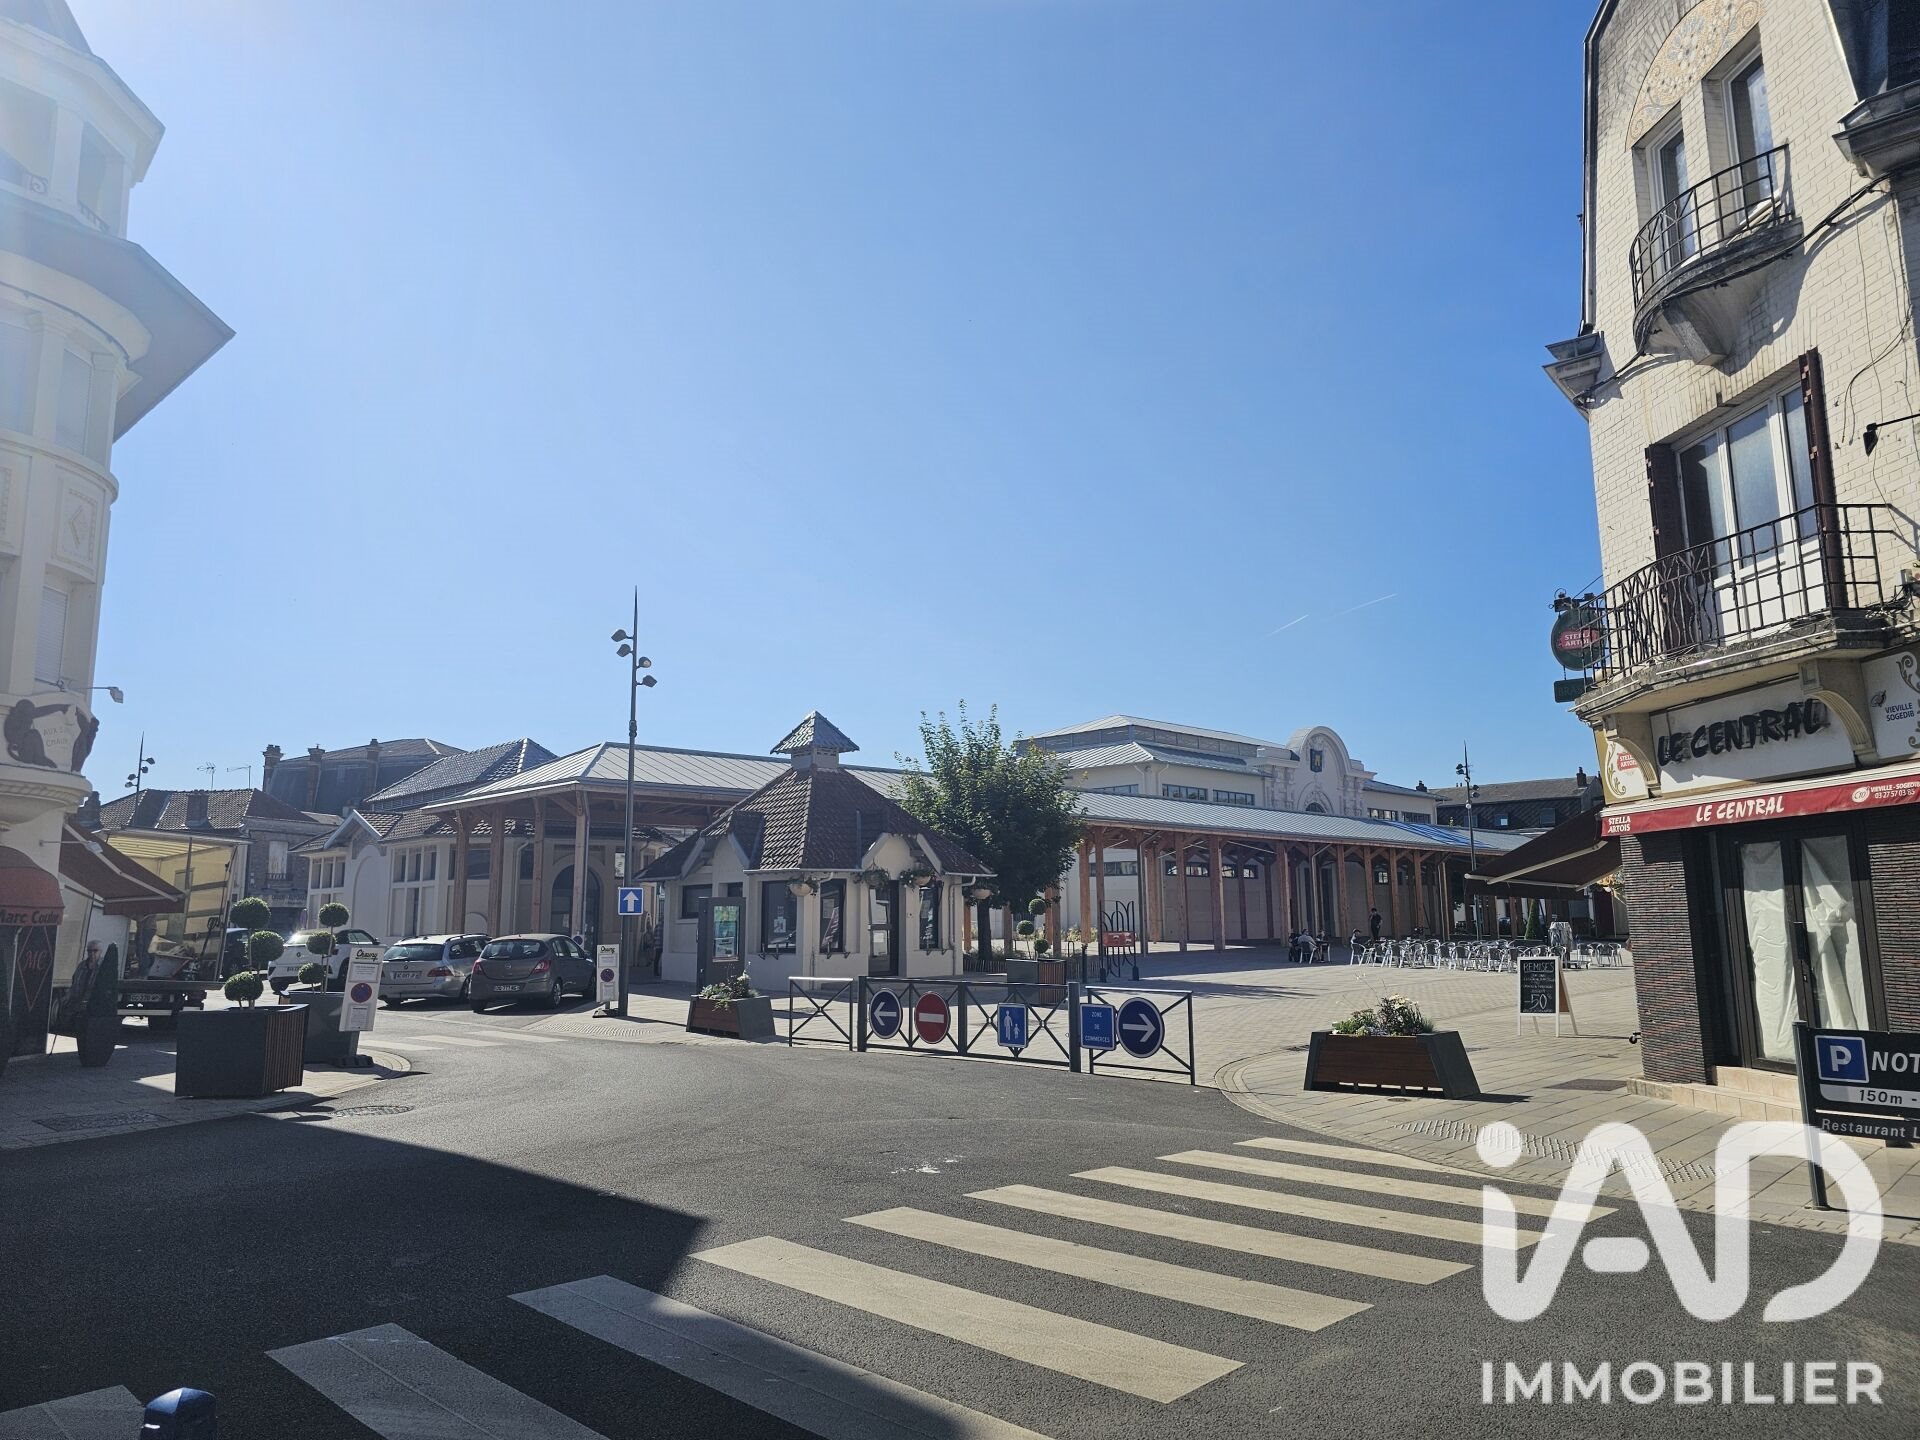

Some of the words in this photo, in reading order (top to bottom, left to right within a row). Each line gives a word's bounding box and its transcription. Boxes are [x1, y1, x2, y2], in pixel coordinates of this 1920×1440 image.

[1564, 632, 1591, 641] STELL
[1885, 702, 1913, 714] VIEVILLE
[1886, 710, 1915, 721] SOGEDIB
[1657, 732, 1690, 766] LE
[1690, 698, 1827, 758] CENTRAL
[1619, 754, 1635, 762] STELL
[1695, 804, 1713, 823] LE
[1716, 795, 1785, 819] CENTRAL
[1608, 815, 1631, 826] STELLA
[1608, 823, 1631, 834] ARTOIS
[1523, 962, 1554, 971] REMISES
[1829, 1045, 1852, 1072] P
[1859, 1089, 1903, 1105] 150m
[1821, 1118, 1906, 1138] Restaurant
